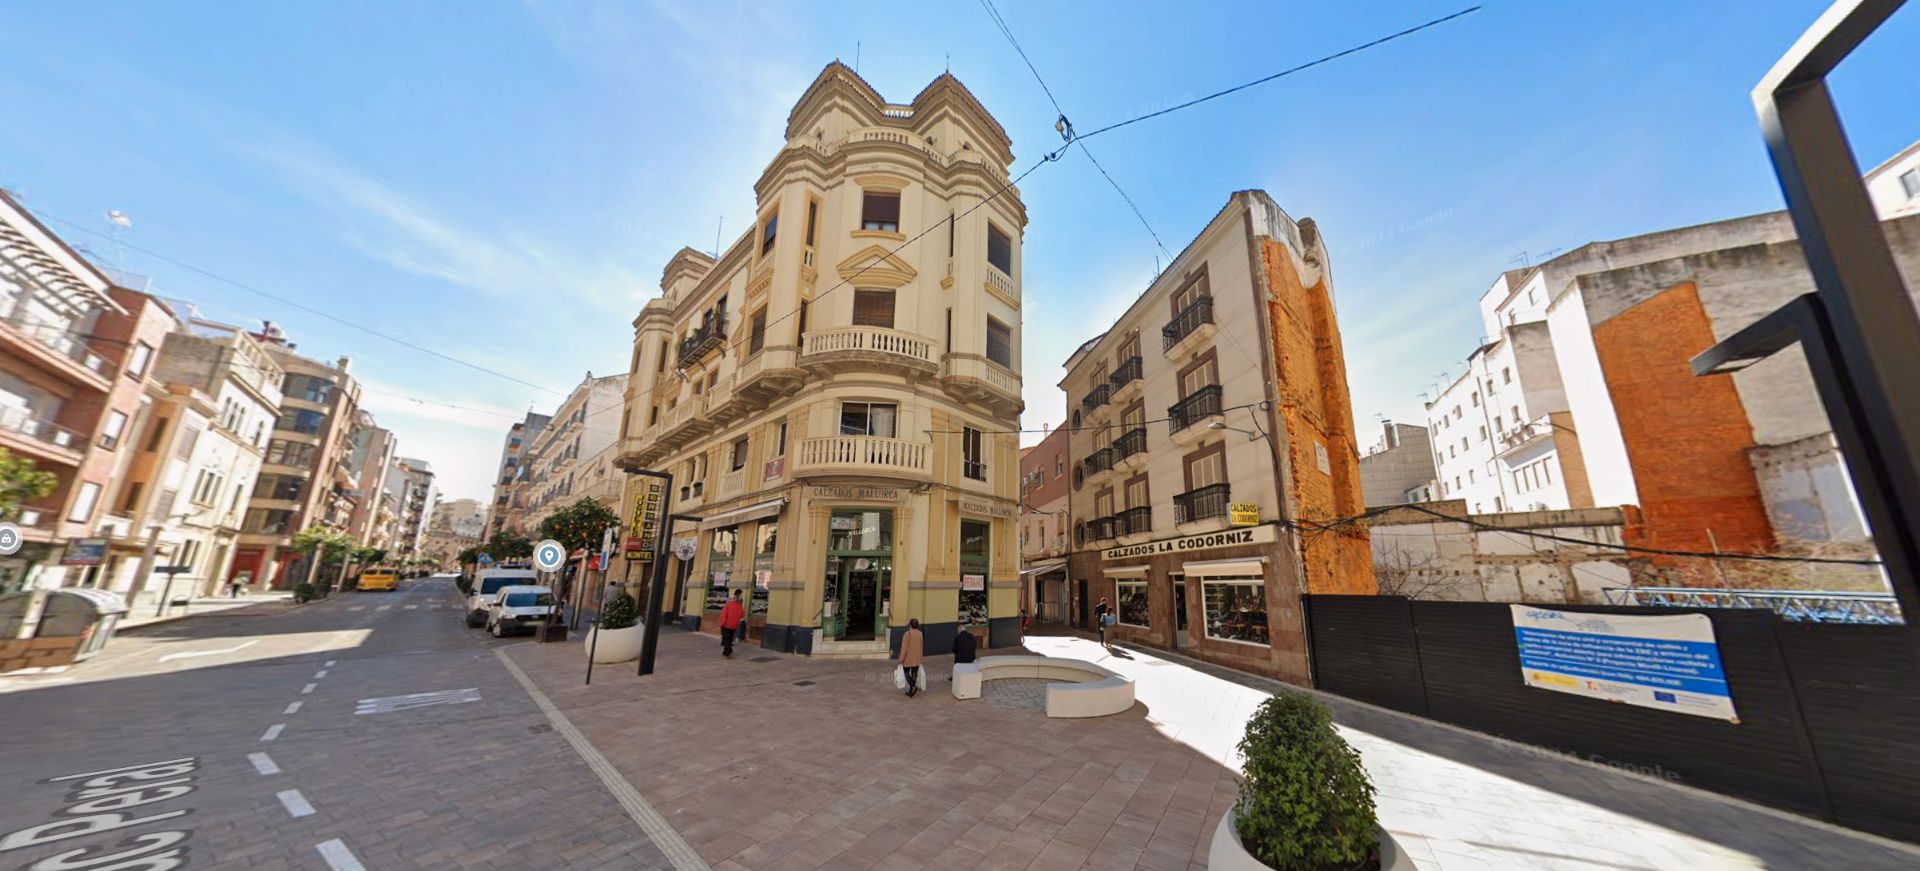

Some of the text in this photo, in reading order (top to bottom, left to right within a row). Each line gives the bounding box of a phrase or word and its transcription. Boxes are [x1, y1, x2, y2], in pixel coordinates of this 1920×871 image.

[814, 487, 898, 500] CALZADOS MALLORCA
[964, 502, 988, 514] CALZADOS
[1231, 503, 1257, 513] CALZADOS
[1231, 513, 1258, 523] LA CODORNIZ
[848, 526, 876, 537] MALLORCA
[1108, 530, 1254, 559] CALZADOS LA CODORNIZ
